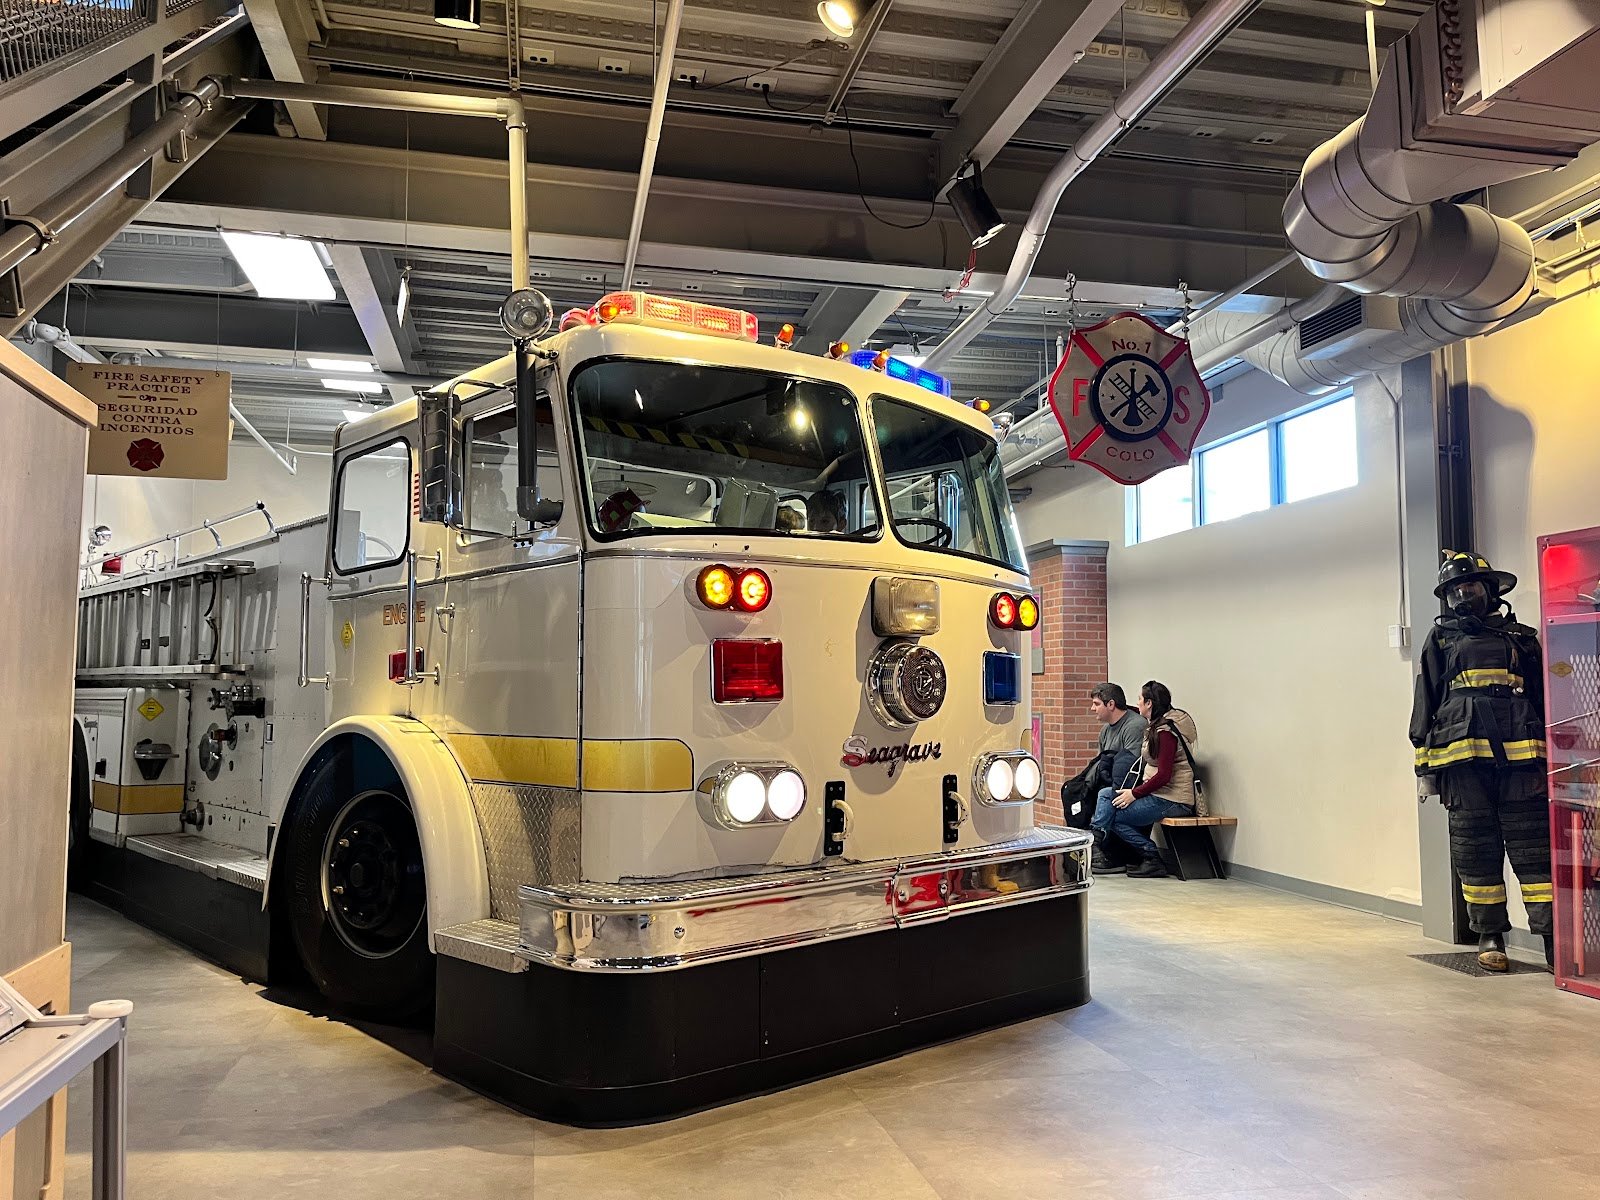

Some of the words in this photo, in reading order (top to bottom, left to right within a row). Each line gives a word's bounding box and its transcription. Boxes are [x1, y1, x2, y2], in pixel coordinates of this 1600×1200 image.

[93, 371, 134, 381] FIRE
[139, 373, 205, 385] SAFETY
[105, 381, 192, 394] PRACTICE
[1072, 378, 1090, 417] F
[1173, 385, 1190, 424] S
[98, 403, 198, 416] SEGURIDAD
[112, 414, 182, 425] CONTRA
[100, 423, 194, 436] INCENDIOS
[1106, 446, 1155, 462] COLO
[383, 600, 426, 626] ENGE
[842, 734, 942, 778] Seagrave
